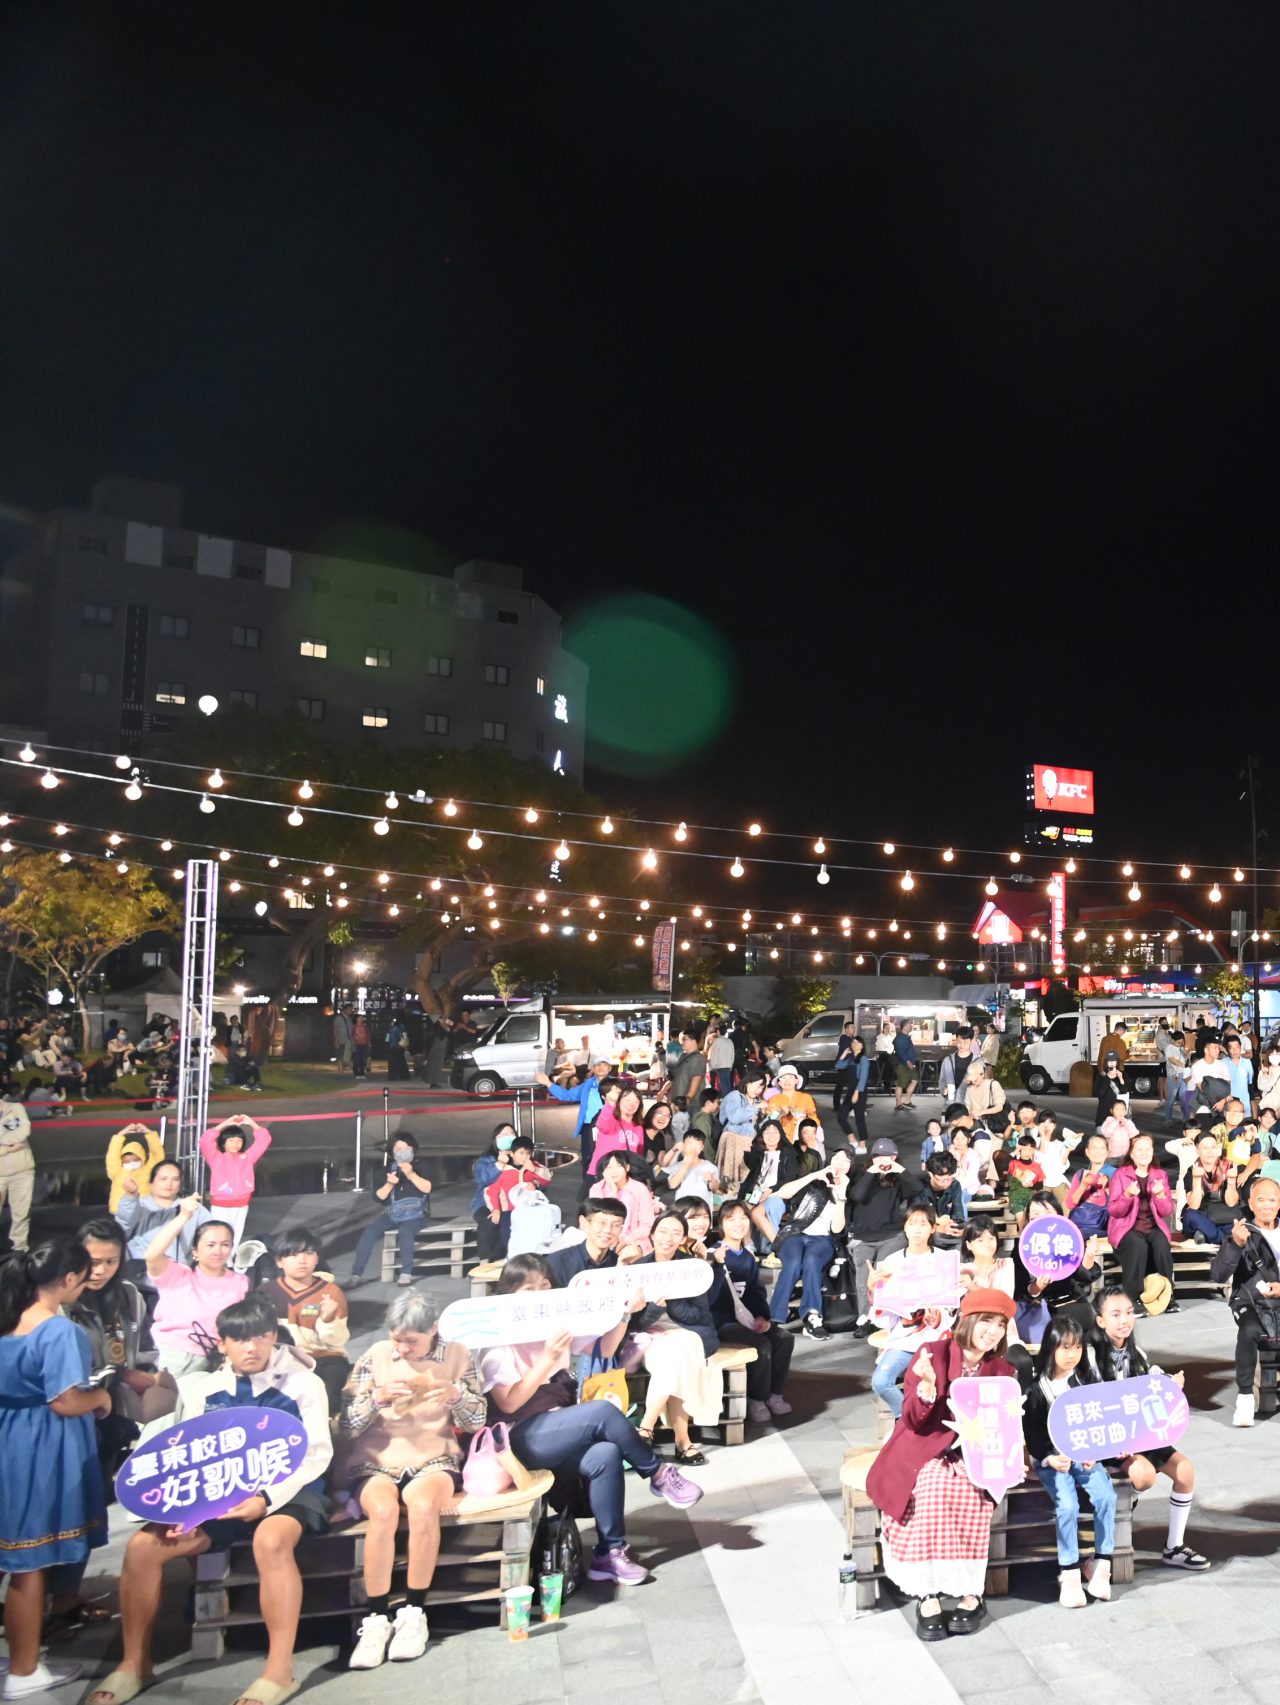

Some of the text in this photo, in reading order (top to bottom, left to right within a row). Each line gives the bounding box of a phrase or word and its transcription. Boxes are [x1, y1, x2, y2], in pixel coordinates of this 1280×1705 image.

[1058, 782, 1087, 799] KFC
[1029, 1232, 1075, 1256] 偶像
[1039, 1258, 1063, 1270] idol
[1064, 1394, 1140, 1426] 再來一首
[131, 1426, 247, 1480] 臺東校園
[161, 1438, 292, 1513] 好歌喉
